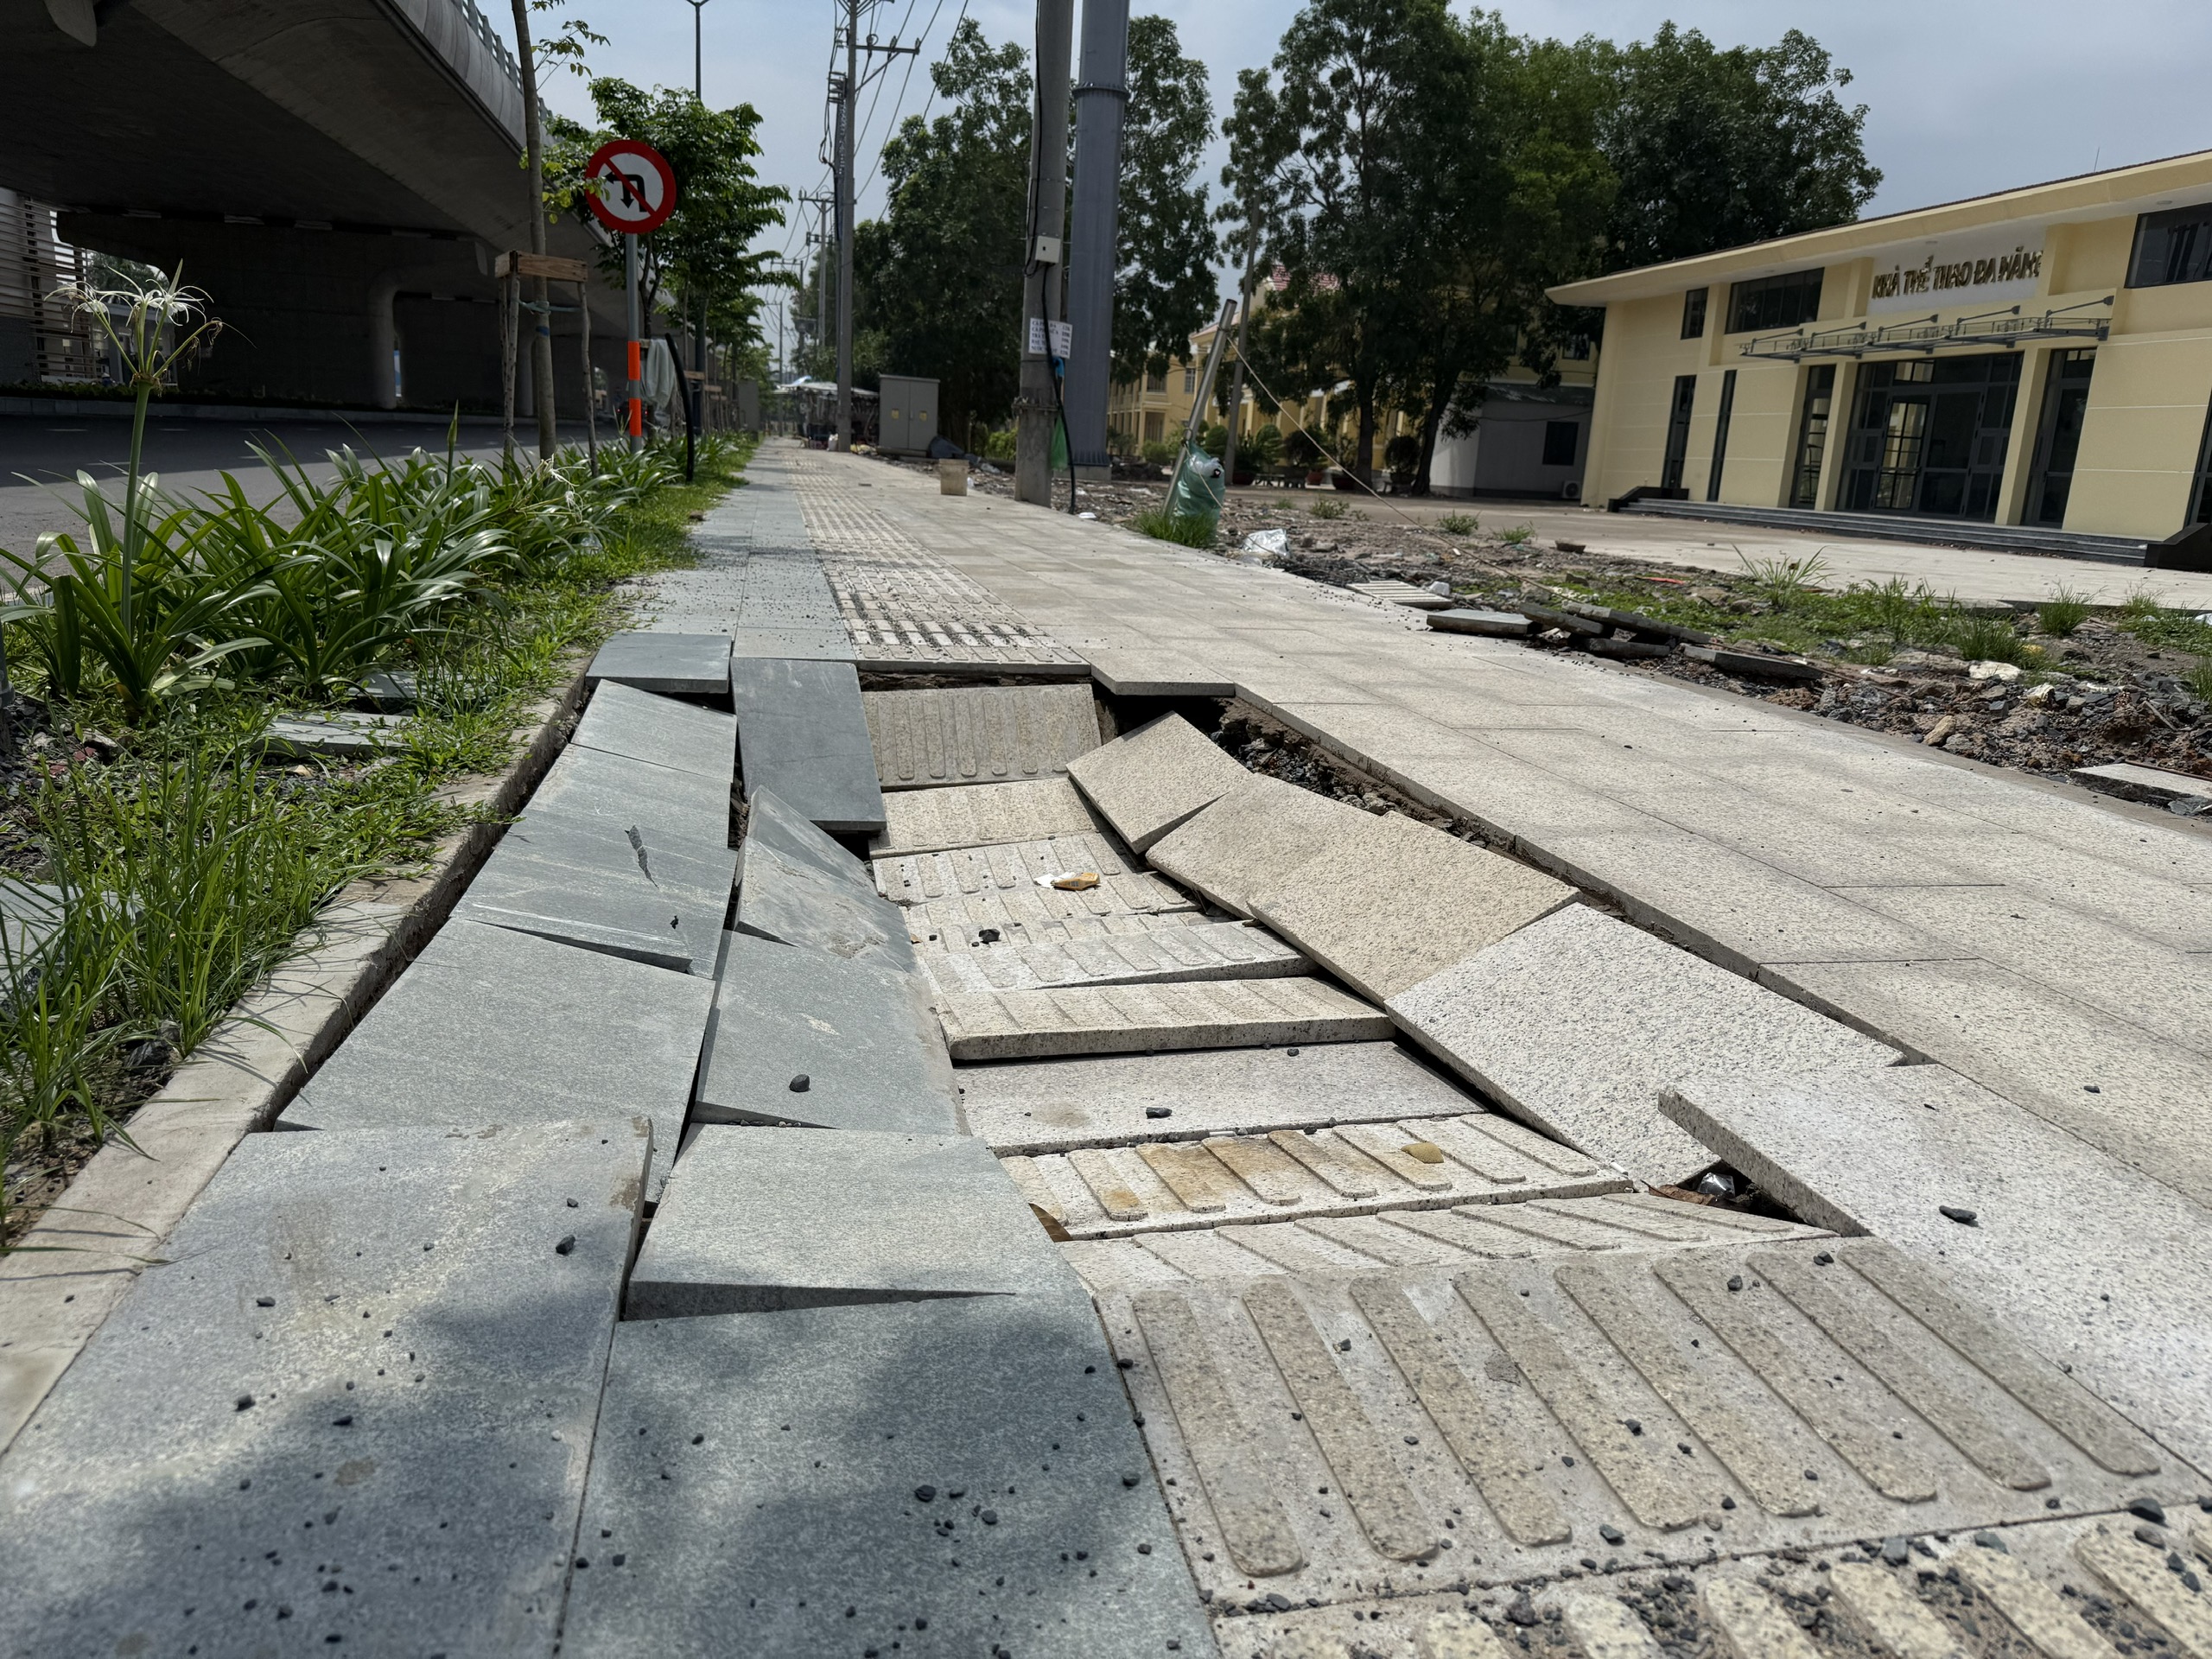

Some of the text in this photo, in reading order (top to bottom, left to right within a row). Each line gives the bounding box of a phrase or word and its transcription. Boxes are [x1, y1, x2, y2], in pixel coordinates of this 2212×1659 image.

[1872, 245, 2044, 299] NHÀ THỂ THAO ĐA NĂNG
